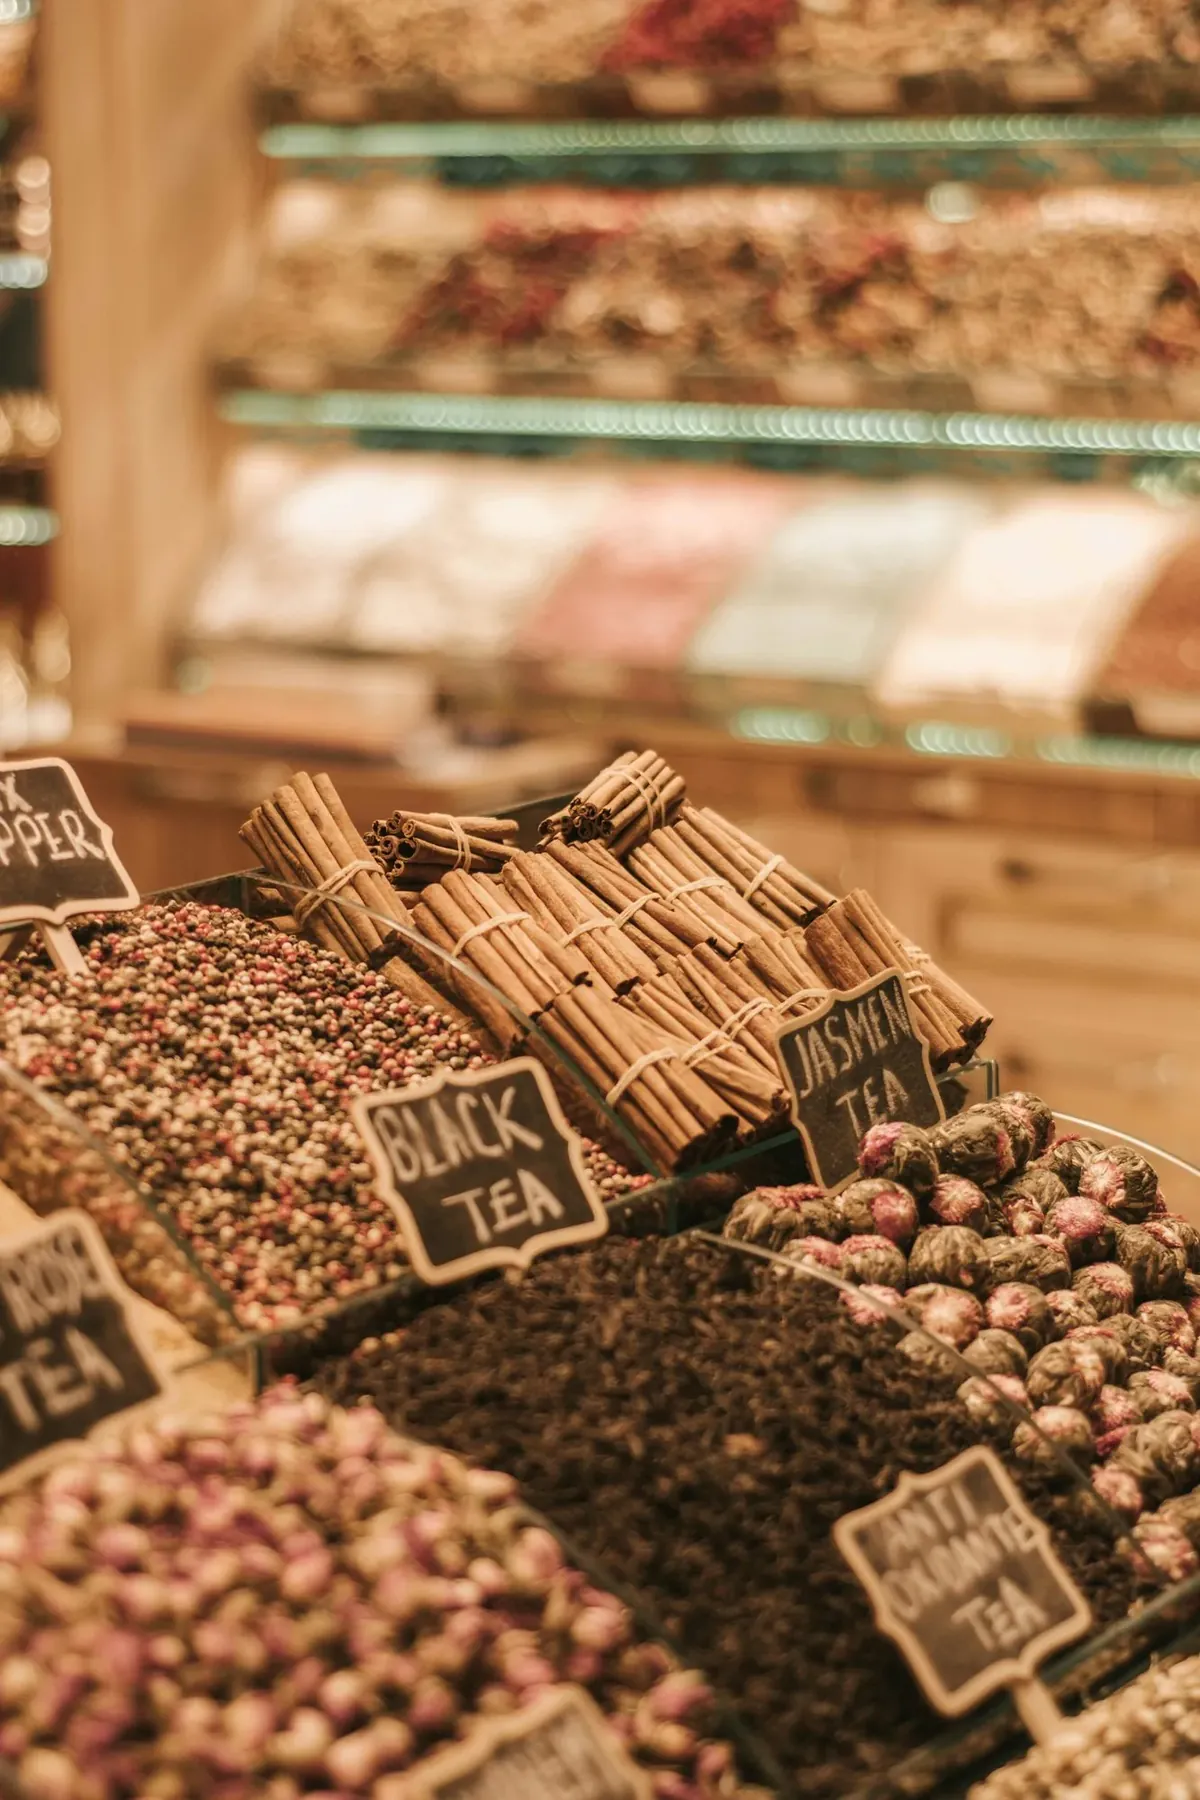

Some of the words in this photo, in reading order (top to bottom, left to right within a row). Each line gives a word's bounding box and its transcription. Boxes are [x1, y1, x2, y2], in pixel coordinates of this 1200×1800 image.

[0, 773, 33, 813] X
[794, 979, 912, 1099] JASMEN
[373, 1086, 544, 1182] BLACK
[835, 1068, 909, 1139] TEA
[441, 1168, 565, 1243] TEA
[0, 1324, 124, 1433] TEA
[881, 1482, 978, 1562] ANTI
[951, 1577, 1048, 1651] TEA
